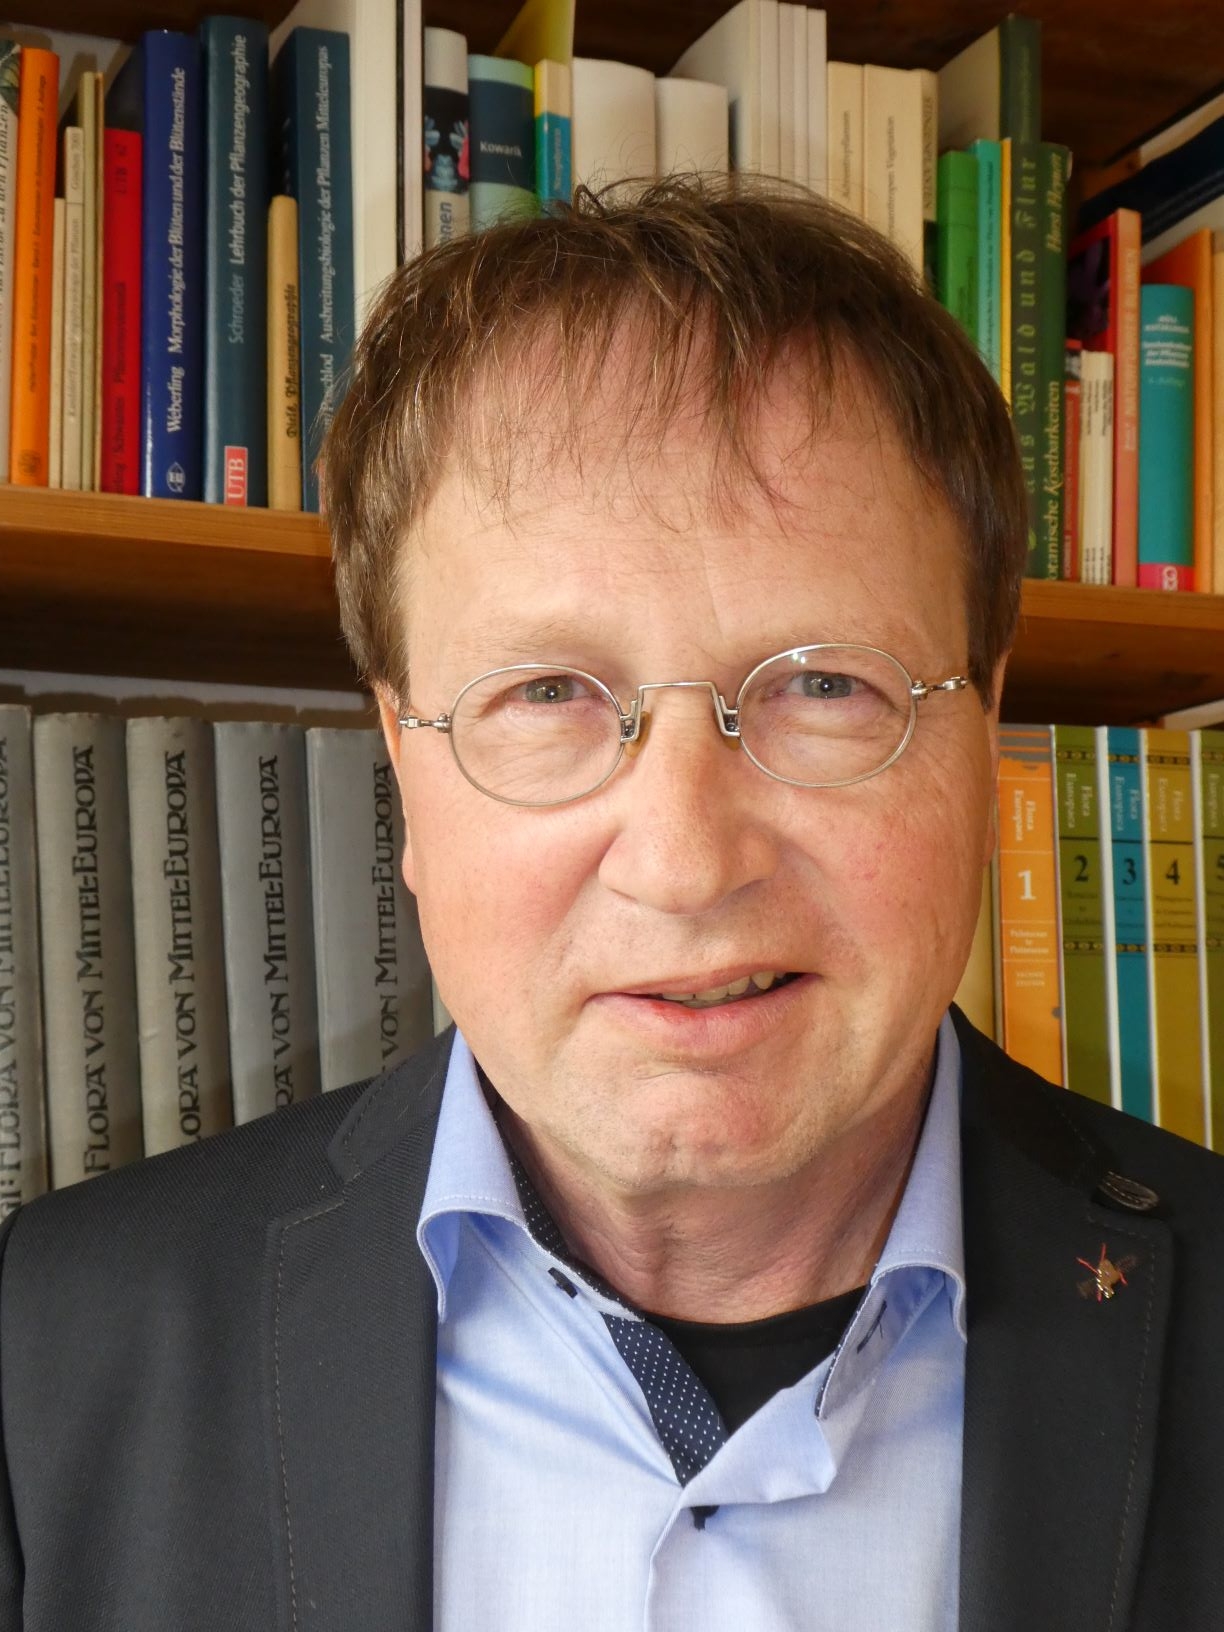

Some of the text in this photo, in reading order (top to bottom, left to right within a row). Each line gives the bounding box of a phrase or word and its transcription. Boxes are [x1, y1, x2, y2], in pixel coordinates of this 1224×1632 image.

[315, 45, 332, 131] Mitteleuropas
[316, 132, 333, 186] Pflanzen
[480, 141, 523, 159] Kowarik
[885, 115, 898, 170] Vegetation
[226, 34, 250, 344] Schroeder Lehrbuch der Pflanzengeographie
[317, 187, 333, 209] der
[1013, 156, 1038, 230] Flur
[166, 67, 186, 432] Weberling Morphologie der Blüten und der Blütenstände
[316, 212, 336, 343] Ausbreitungsbiologie
[1014, 247, 1037, 308] und
[1014, 320, 1038, 415] Wald
[1042, 380, 1064, 497] Kostbarkeiten
[226, 458, 246, 499] UTB
[1025, 800, 1037, 832] Flora
[1080, 785, 1094, 817] Flora
[1129, 788, 1142, 820] Flora
[1172, 789, 1184, 822] Flora
[1017, 868, 1037, 901] 1
[1073, 853, 1090, 884] 2
[1120, 856, 1137, 886] 3
[1165, 858, 1181, 887] 4
[82, 989, 105, 1058] VON
[174, 992, 201, 1059] VON
[270, 992, 292, 1059] VON
[379, 994, 399, 1064] VON
[83, 1064, 110, 1174] FLORA
